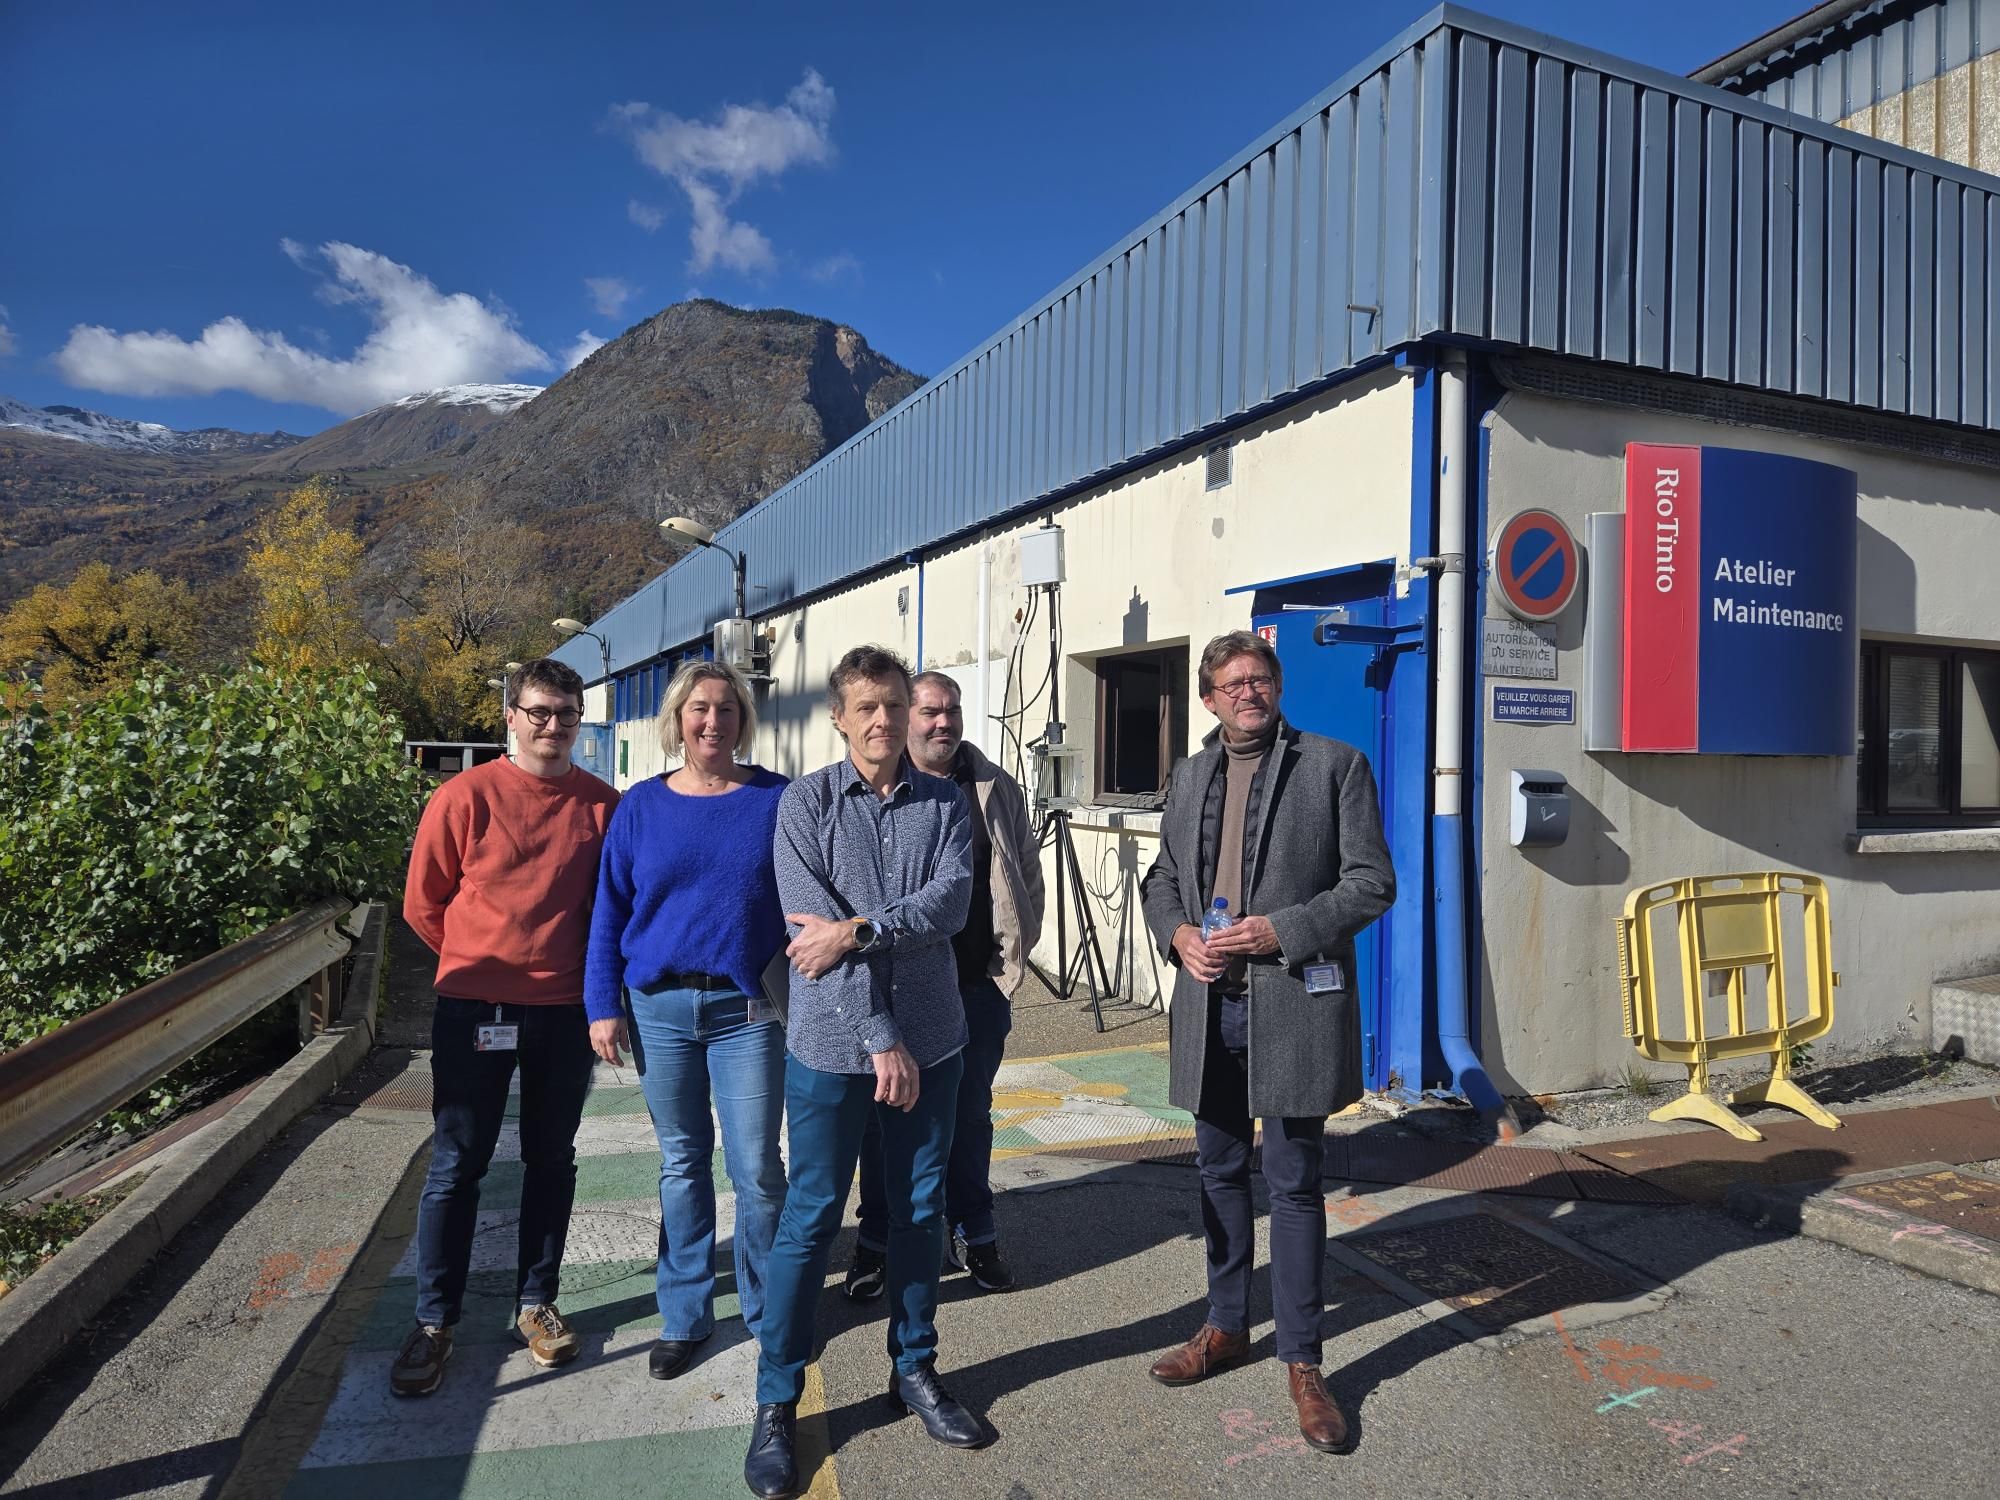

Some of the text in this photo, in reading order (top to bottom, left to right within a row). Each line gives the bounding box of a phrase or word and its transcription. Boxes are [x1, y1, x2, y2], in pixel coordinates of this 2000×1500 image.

[1714, 557, 1796, 587] Atelier
[1713, 597, 1843, 632] Maintenance
[1508, 621, 1534, 631] SAUF
[1485, 633, 1556, 647] AUTORISATION
[1491, 647, 1550, 661] DU SERVICE
[1484, 664, 1554, 677] MAINTENANCE
[1496, 692, 1570, 703] VEUILLEZ VOUS GARER
[1499, 705, 1567, 716] EN MARCHE ARRIERE
